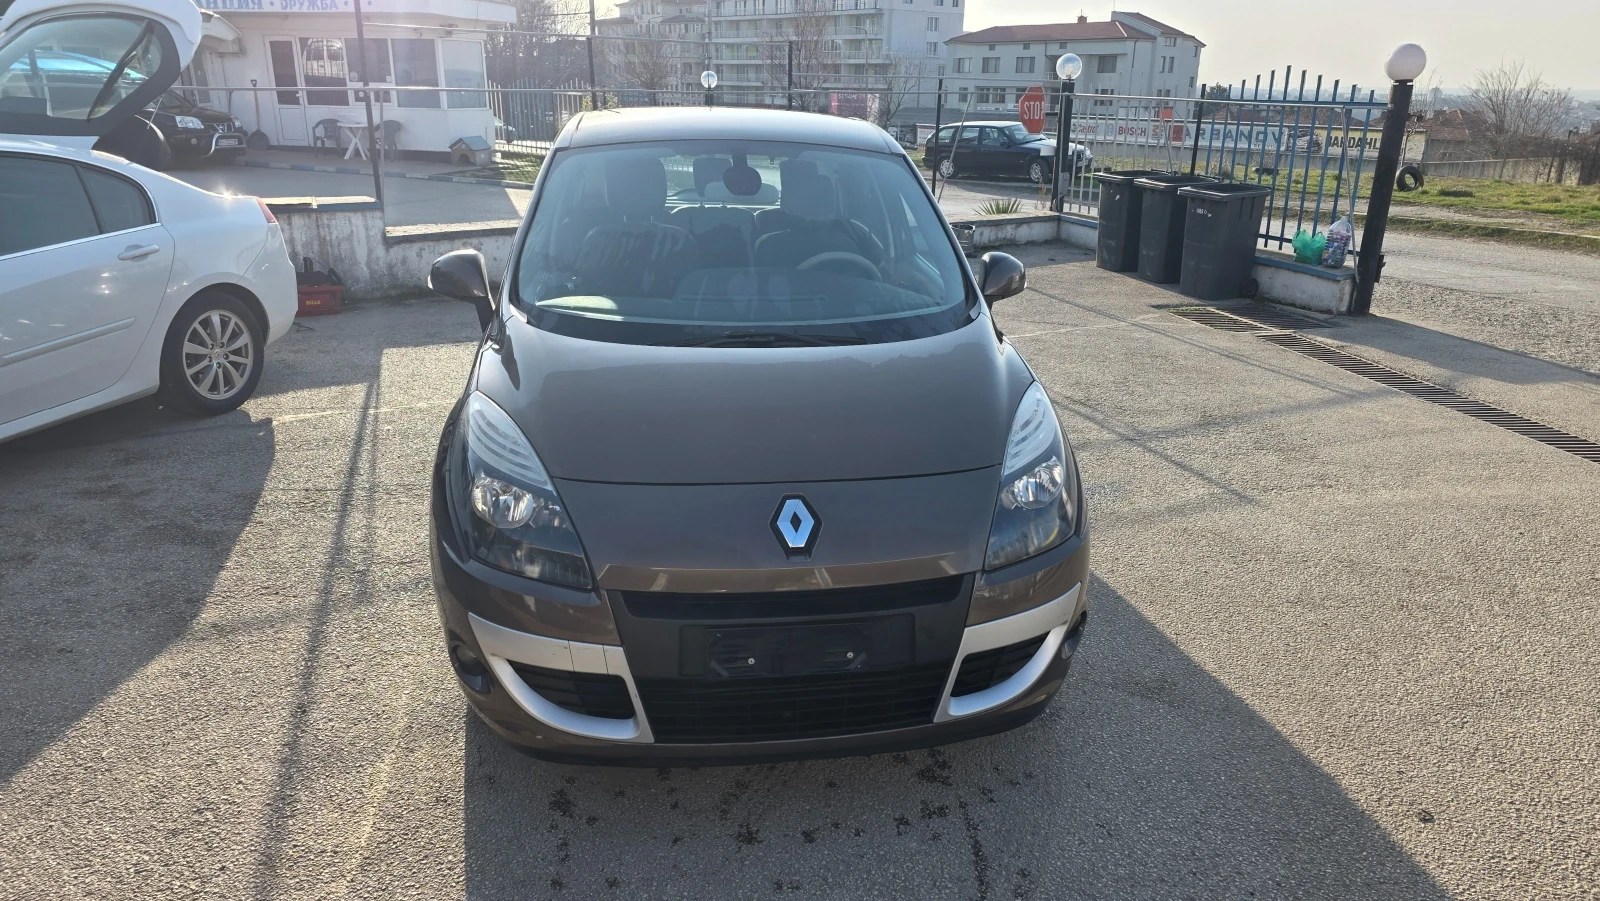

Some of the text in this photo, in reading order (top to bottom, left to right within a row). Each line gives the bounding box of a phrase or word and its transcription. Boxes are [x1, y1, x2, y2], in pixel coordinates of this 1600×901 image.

[1024, 101, 1045, 120] STOP
[1117, 126, 1147, 137] BOSCH
[1327, 135, 1380, 150] ADAHL
